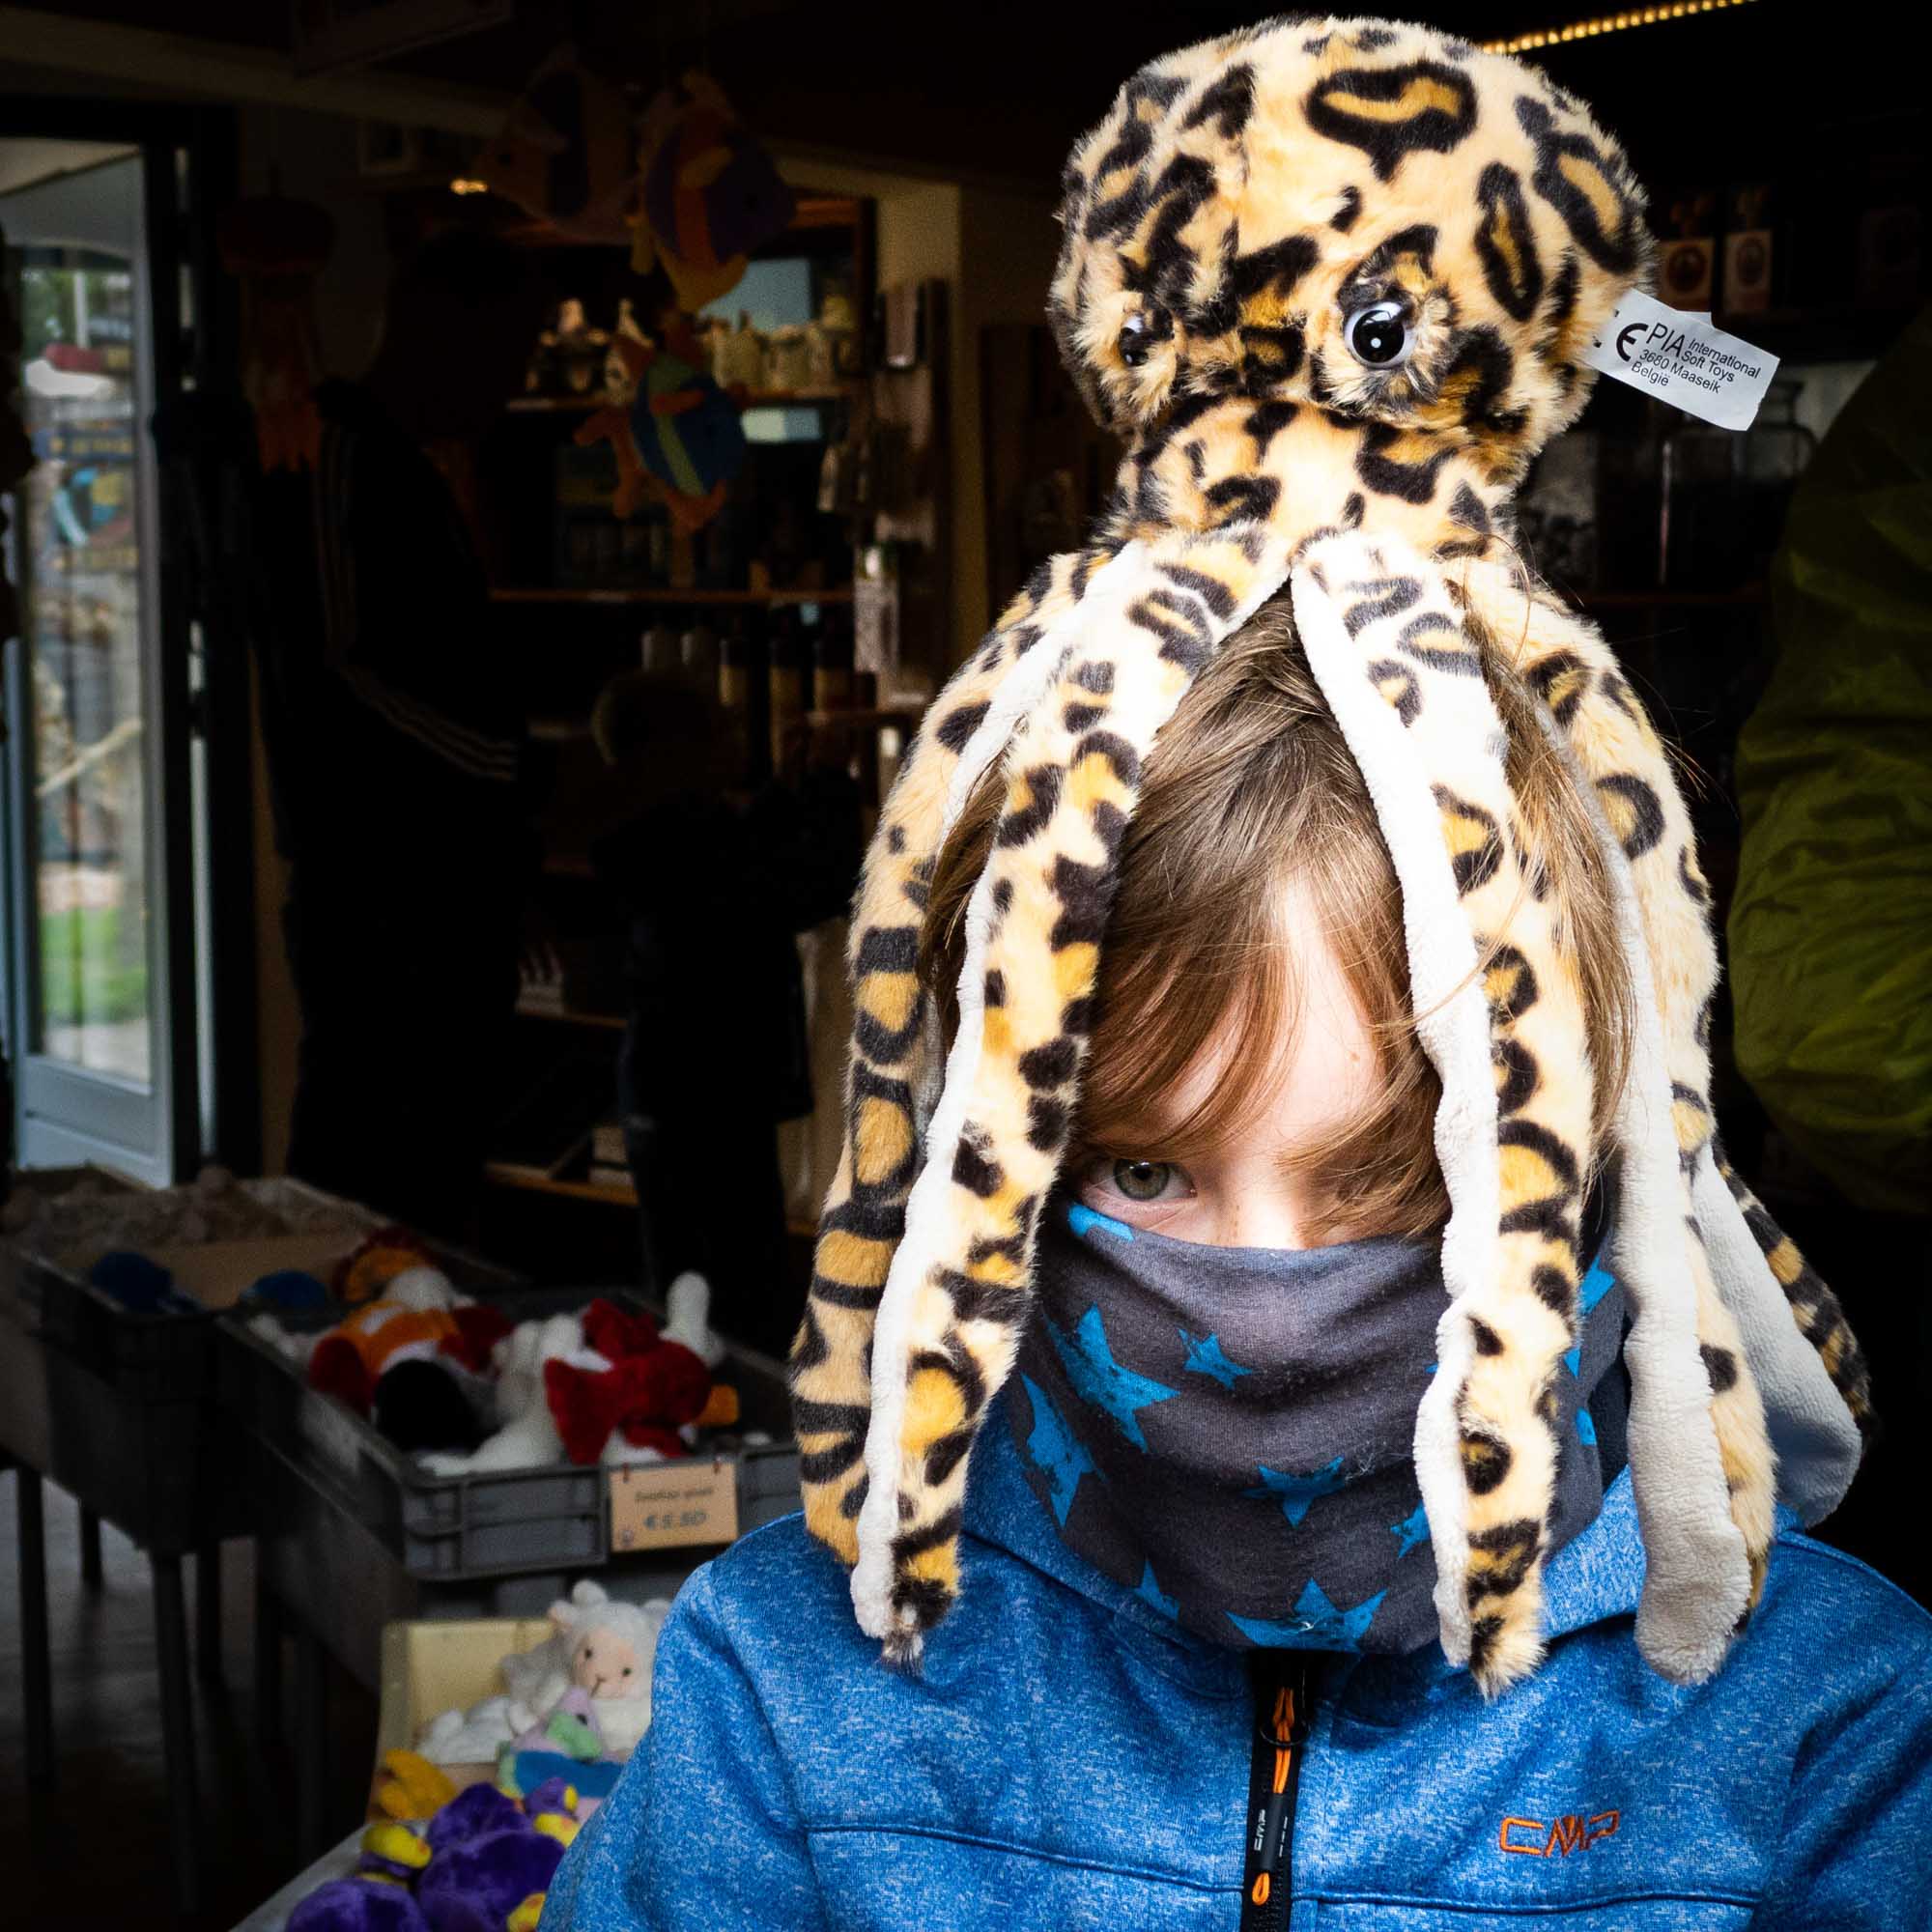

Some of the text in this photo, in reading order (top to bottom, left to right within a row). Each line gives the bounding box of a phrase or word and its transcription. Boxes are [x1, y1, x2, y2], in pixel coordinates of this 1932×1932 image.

[1632, 361, 1670, 386] België
[1639, 349, 1721, 394] 3680 Maaseik
[1646, 323, 1761, 379] PIA International
[1681, 351, 1735, 383] Soft Toys
[1499, 1809, 1621, 1858] CMP
